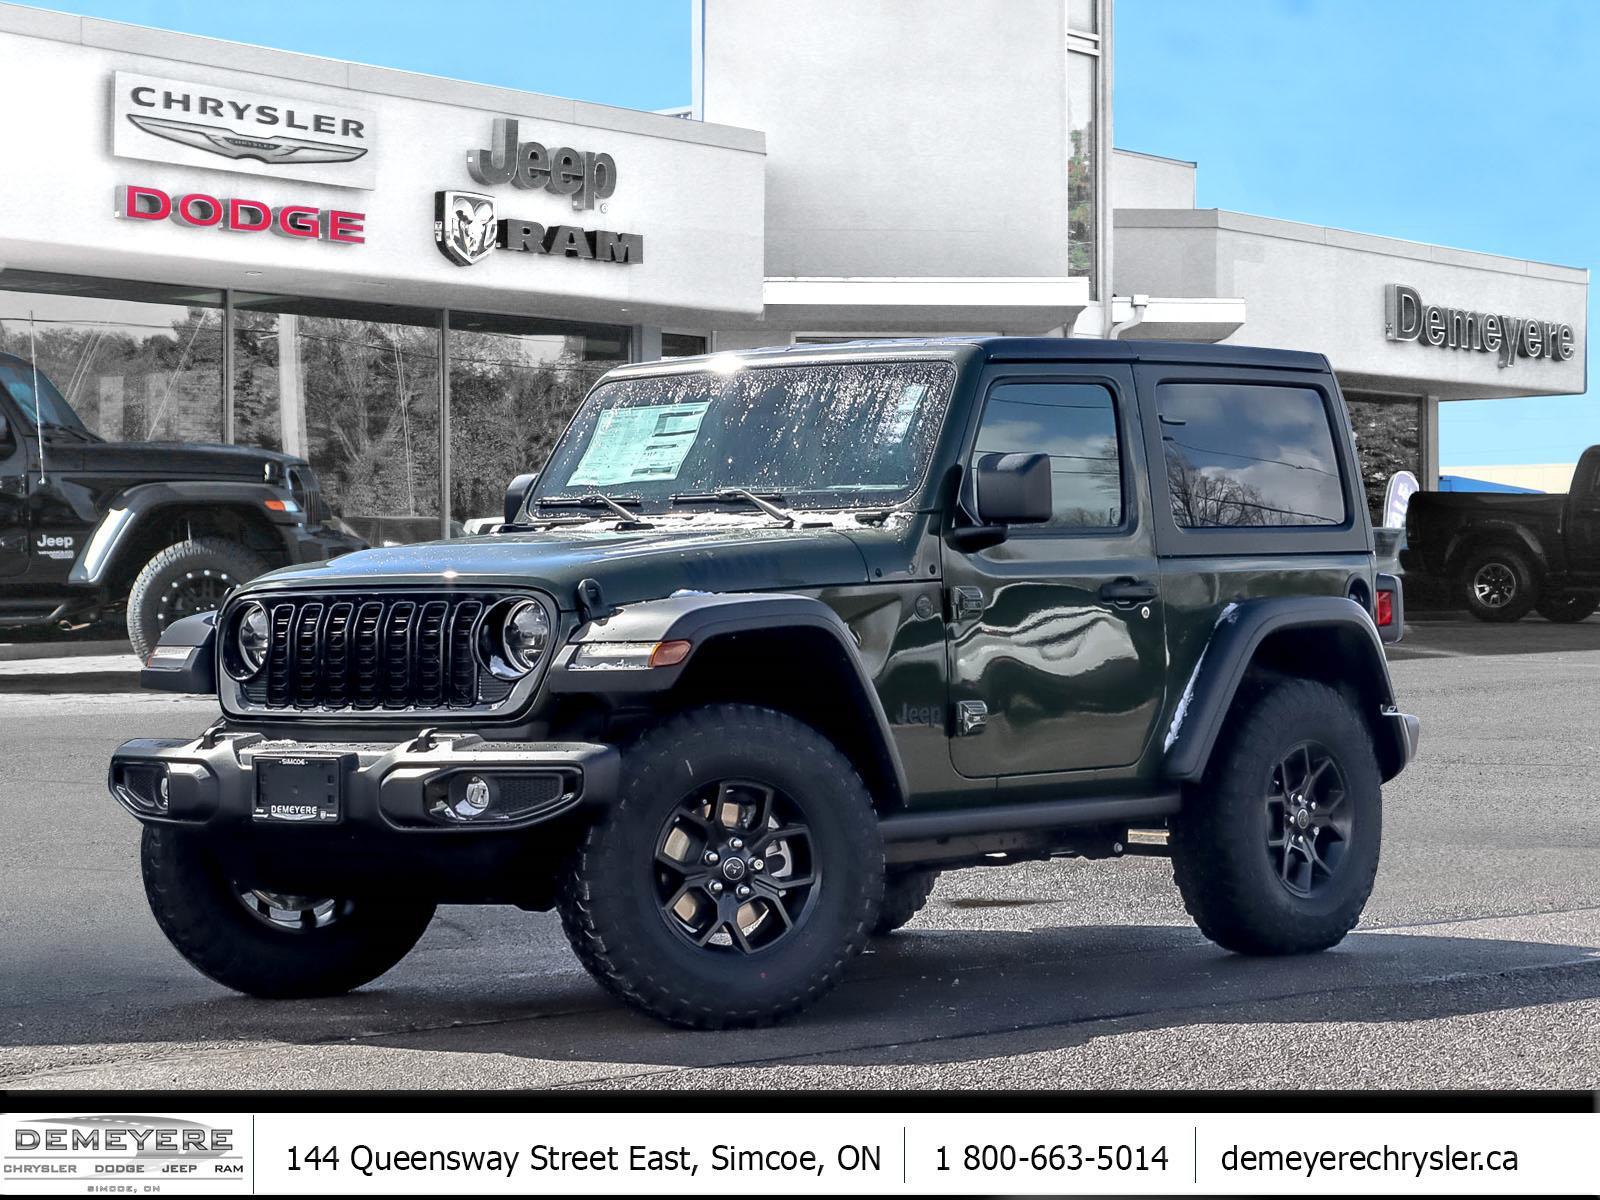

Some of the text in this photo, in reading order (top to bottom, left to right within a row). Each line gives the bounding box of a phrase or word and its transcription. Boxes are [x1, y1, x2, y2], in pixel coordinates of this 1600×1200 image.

[130, 86, 366, 139] CHRYSLER
[468, 118, 617, 210] Jeep
[117, 184, 366, 244] DODGE
[500, 218, 644, 264] RAM
[1386, 283, 1575, 367] Demeyere
[37, 534, 73, 548] Jeep
[896, 702, 942, 729] Jeep
[271, 805, 317, 814] DEMEYERE
